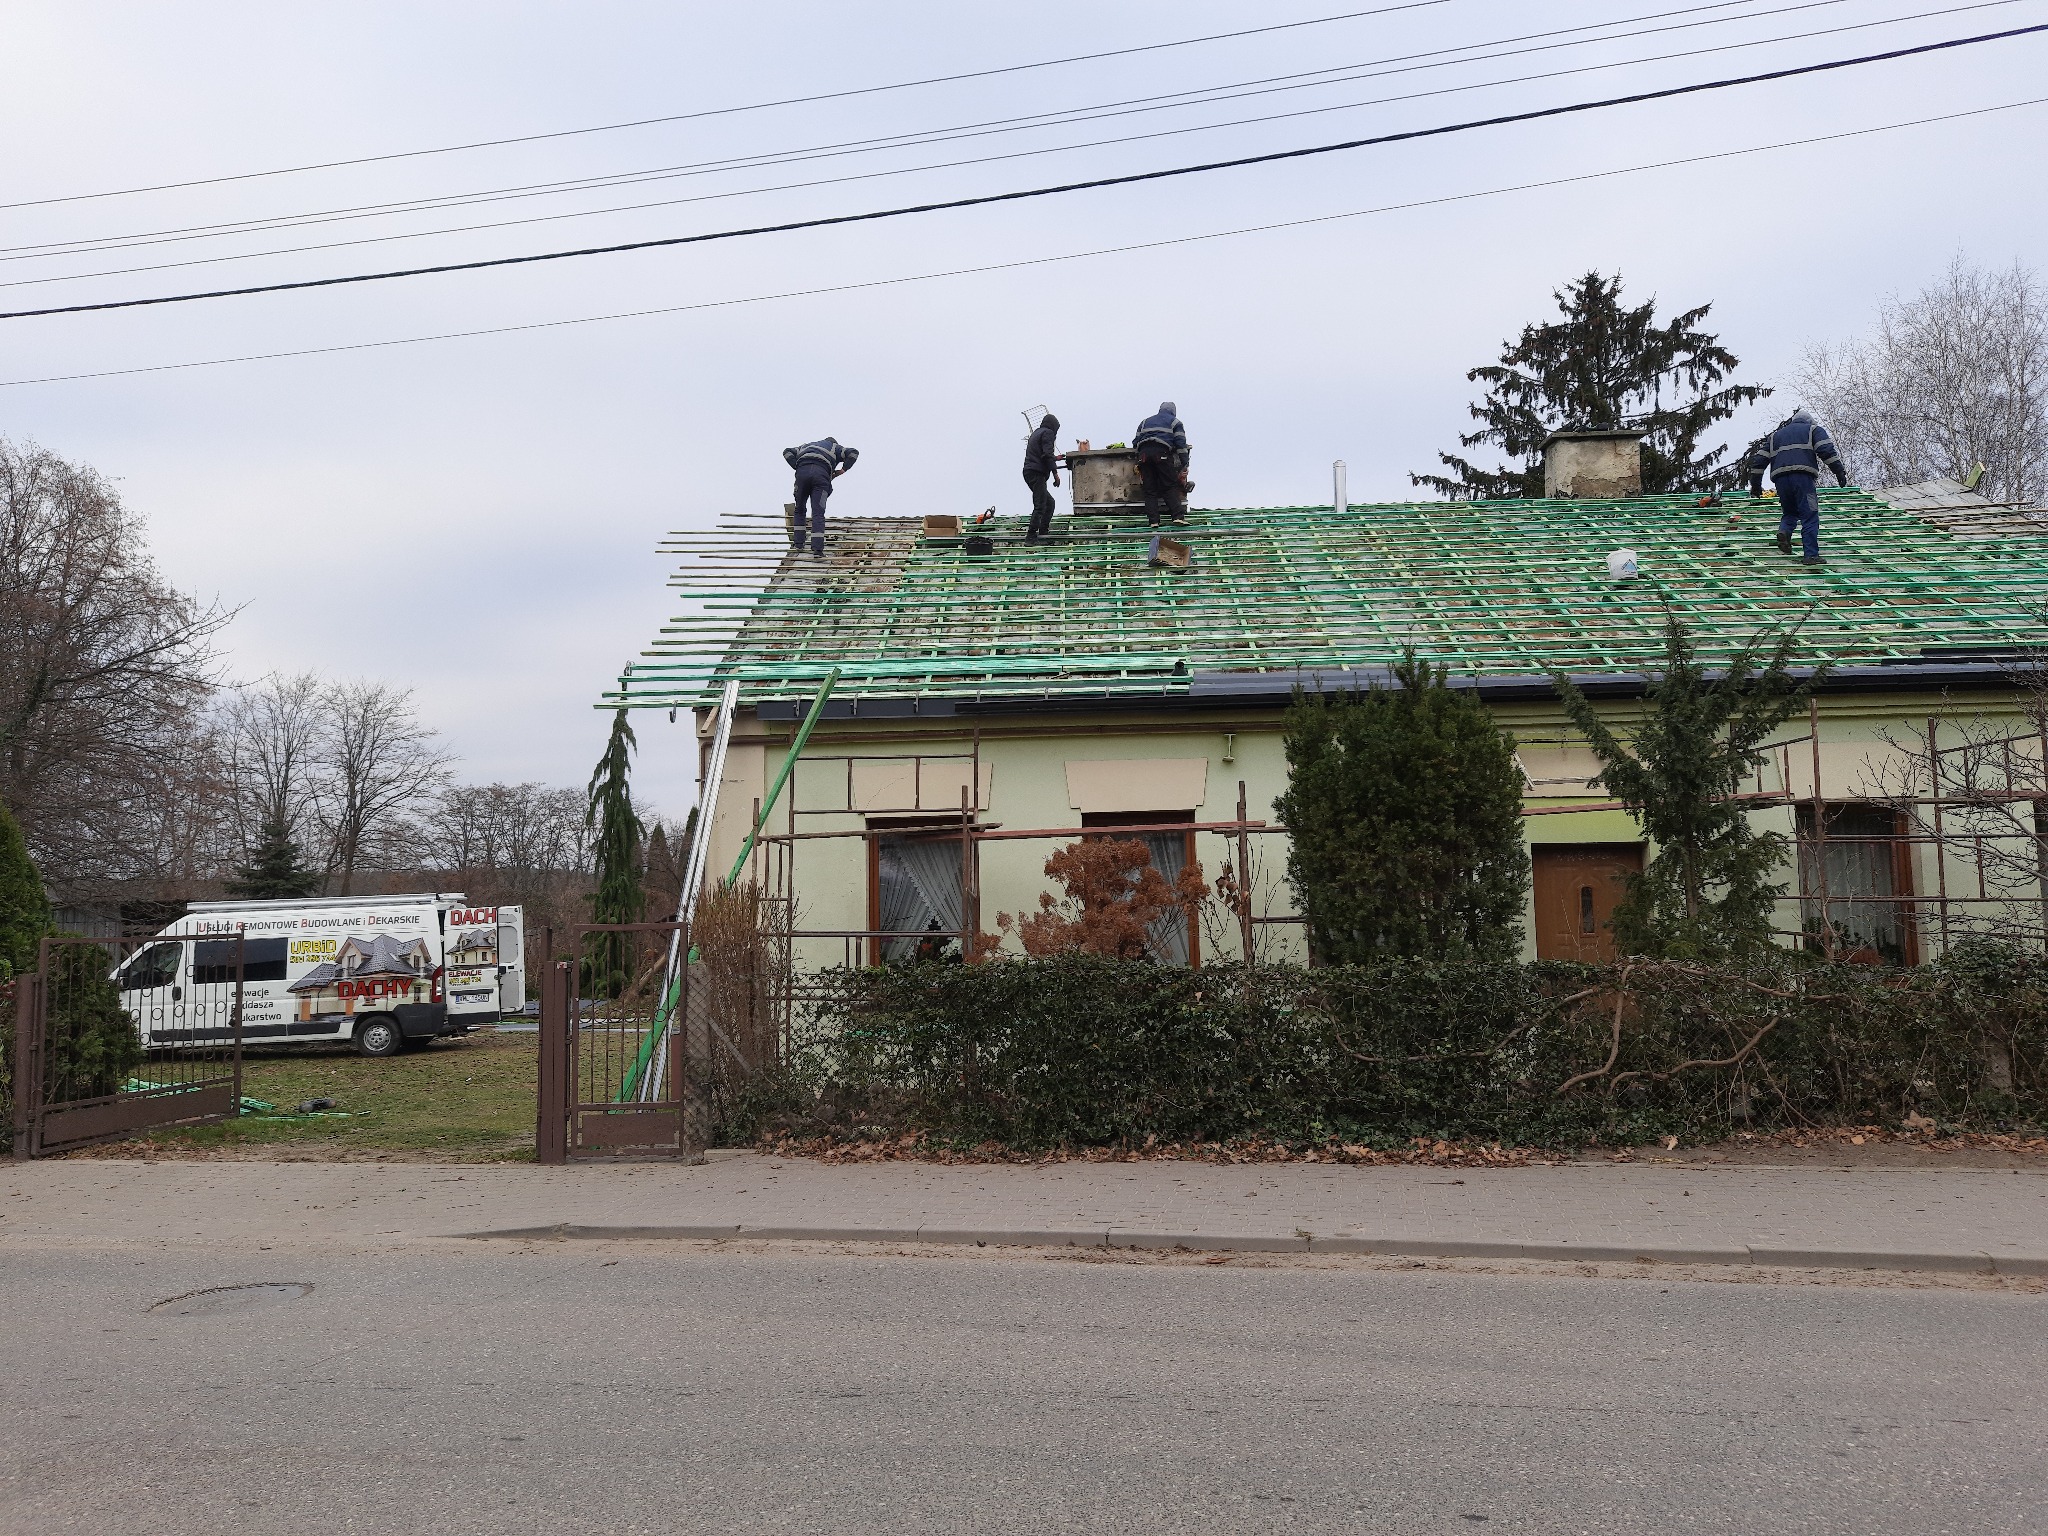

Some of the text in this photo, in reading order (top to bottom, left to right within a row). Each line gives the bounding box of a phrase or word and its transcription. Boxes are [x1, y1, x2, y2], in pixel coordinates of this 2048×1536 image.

[236, 921, 299, 931] REMONTOWE
[301, 918, 361, 928] BUDOWLANE
[368, 915, 420, 926] DEKARSKIE
[450, 908, 497, 925] DACH
[231, 988, 269, 998] ewacje
[337, 978, 413, 1000] DACHY
[231, 1001, 273, 1011] pddasza
